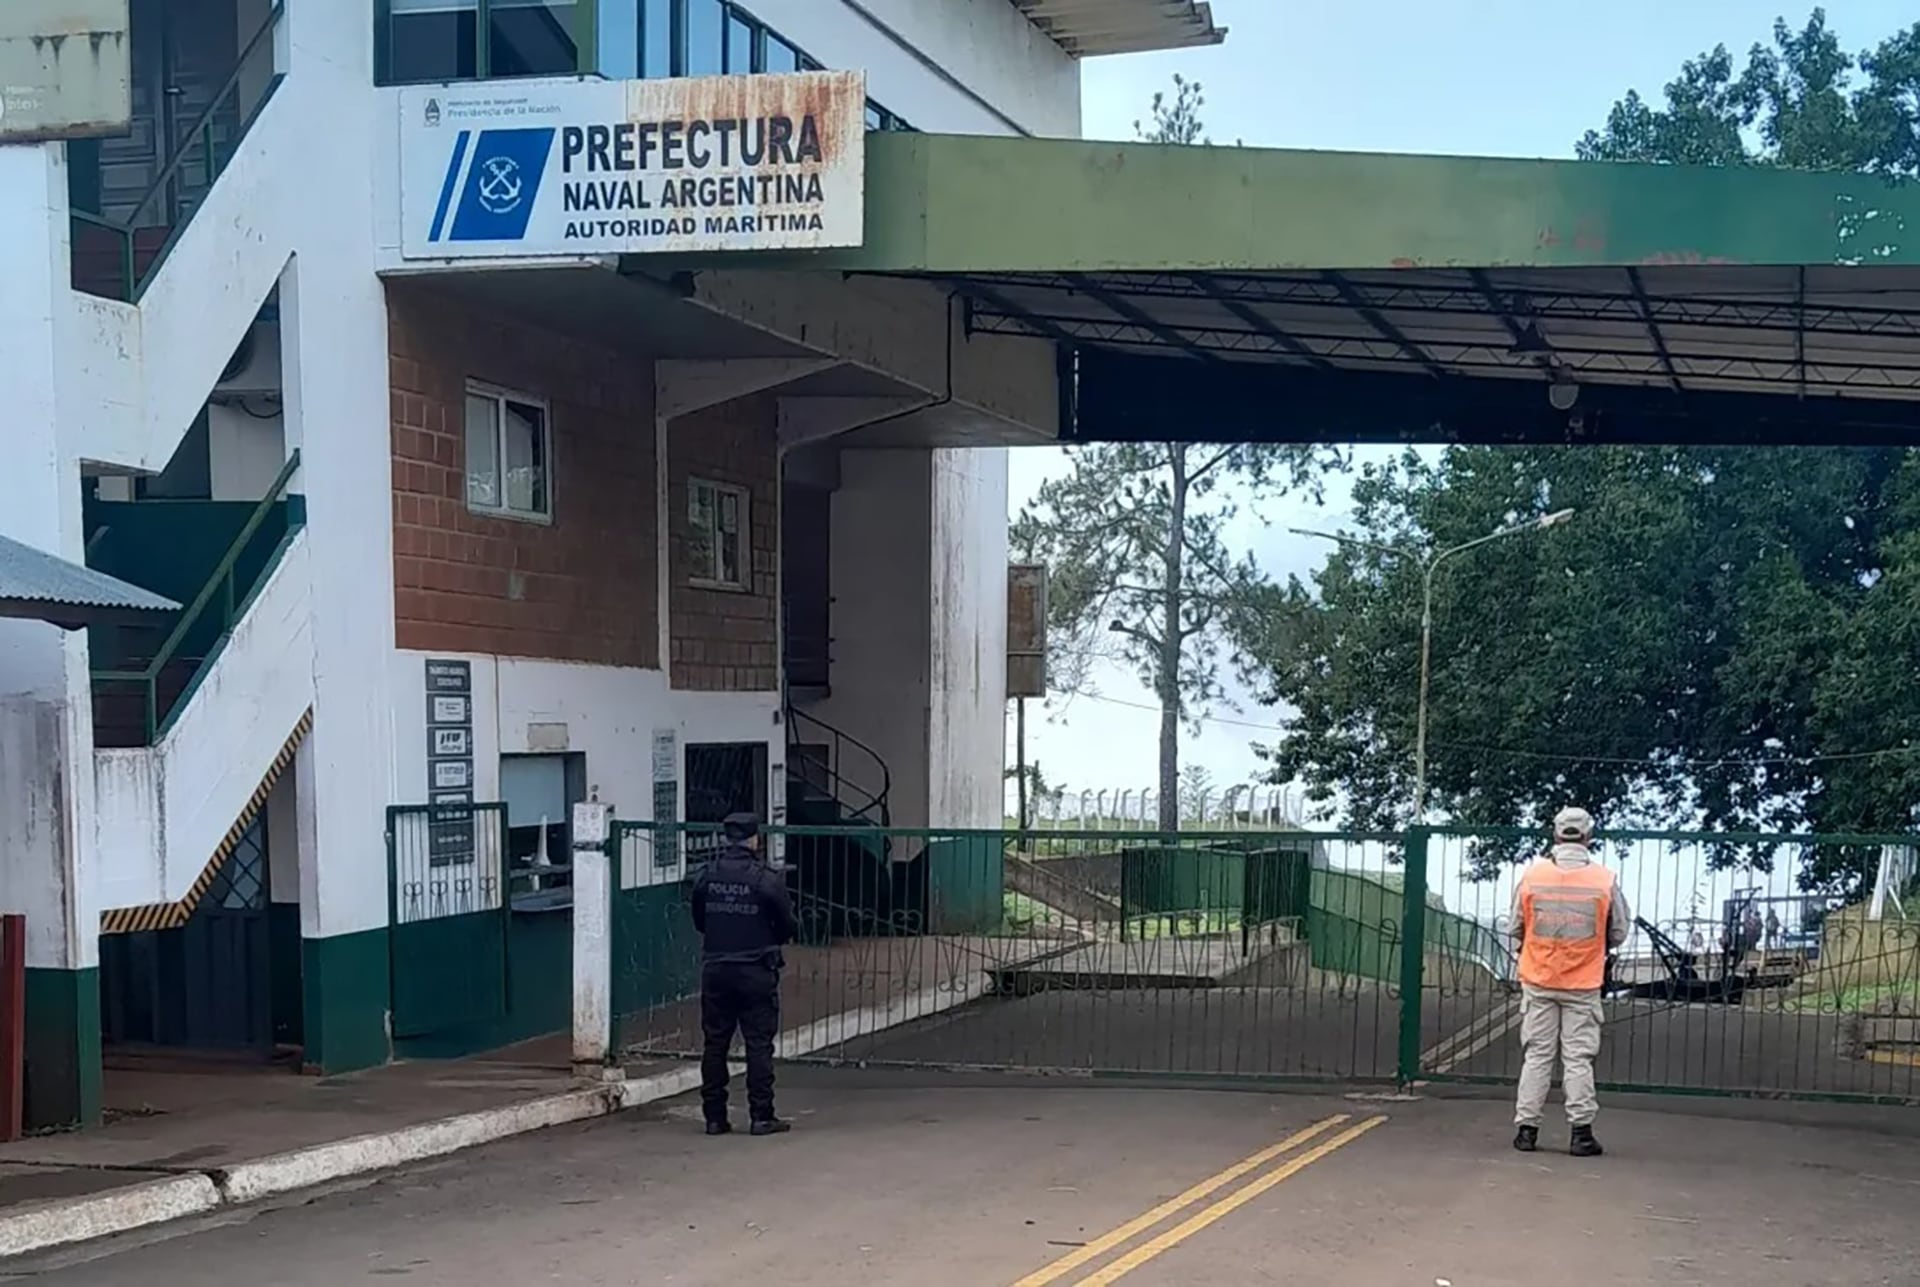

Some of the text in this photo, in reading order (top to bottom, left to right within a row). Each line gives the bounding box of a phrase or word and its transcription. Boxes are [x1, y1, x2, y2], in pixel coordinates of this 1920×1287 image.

[503, 107, 515, 115] de
[517, 106, 526, 114] la
[562, 115, 823, 173] PREFECTURA
[563, 173, 824, 212] NAVAL ARGENTINA
[564, 211, 824, 239] AUTORIDAD MARÍTIMA
